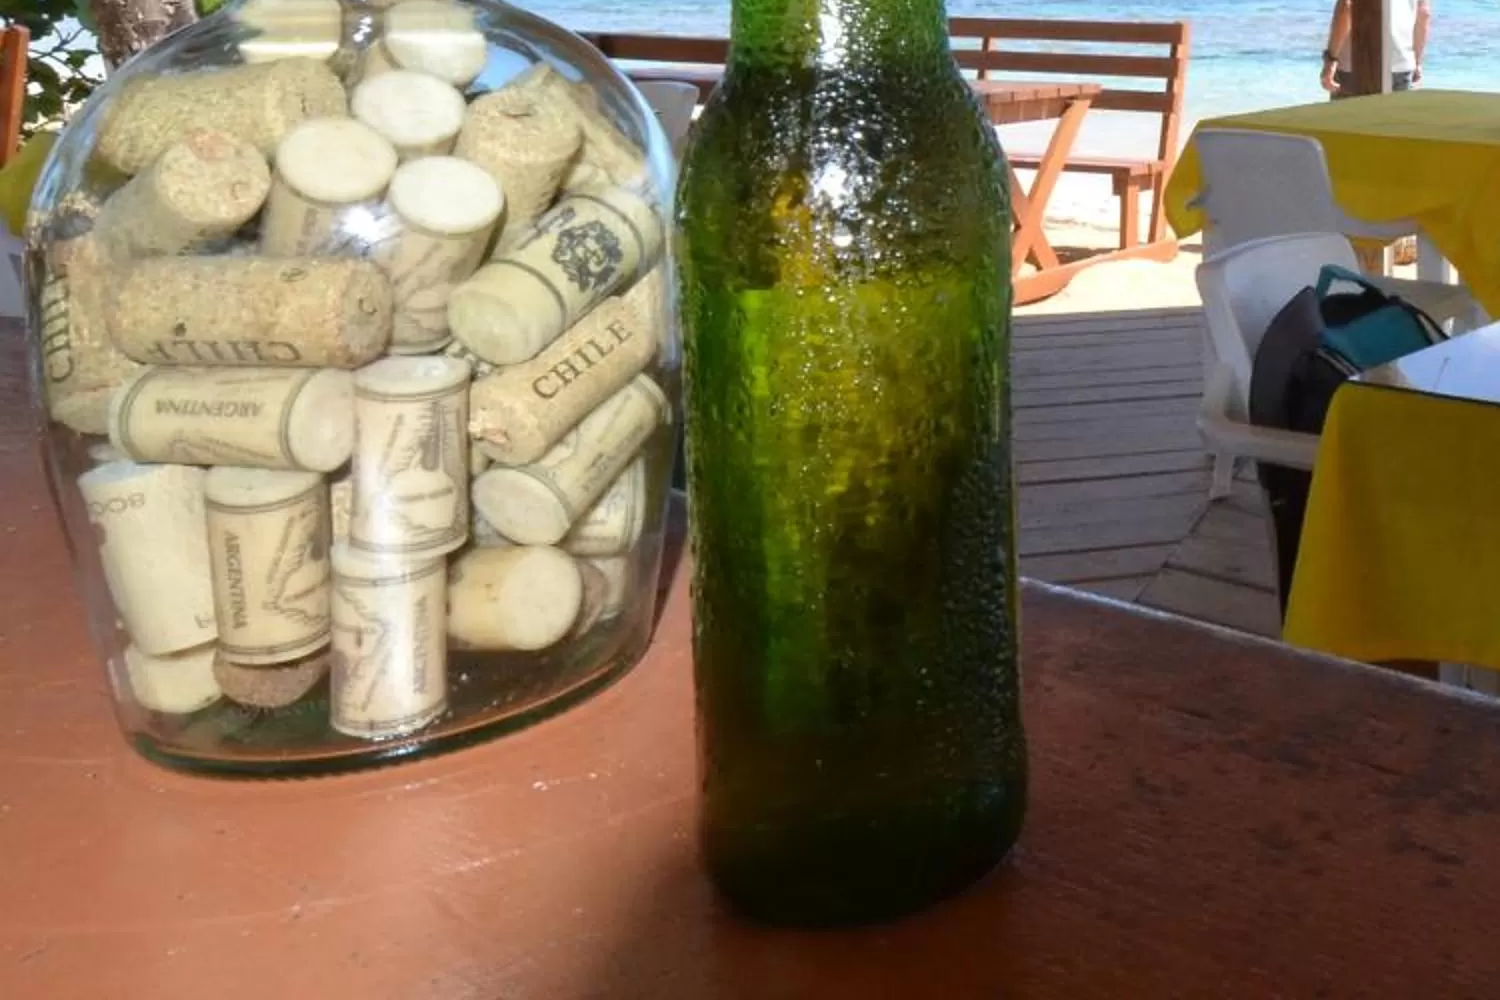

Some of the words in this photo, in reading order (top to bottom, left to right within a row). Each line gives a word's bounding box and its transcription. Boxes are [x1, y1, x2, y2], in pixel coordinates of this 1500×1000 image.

[532, 319, 633, 399] CHILE
[155, 398, 264, 418] ARGENTINA
[224, 530, 248, 630] ARGENTINA
